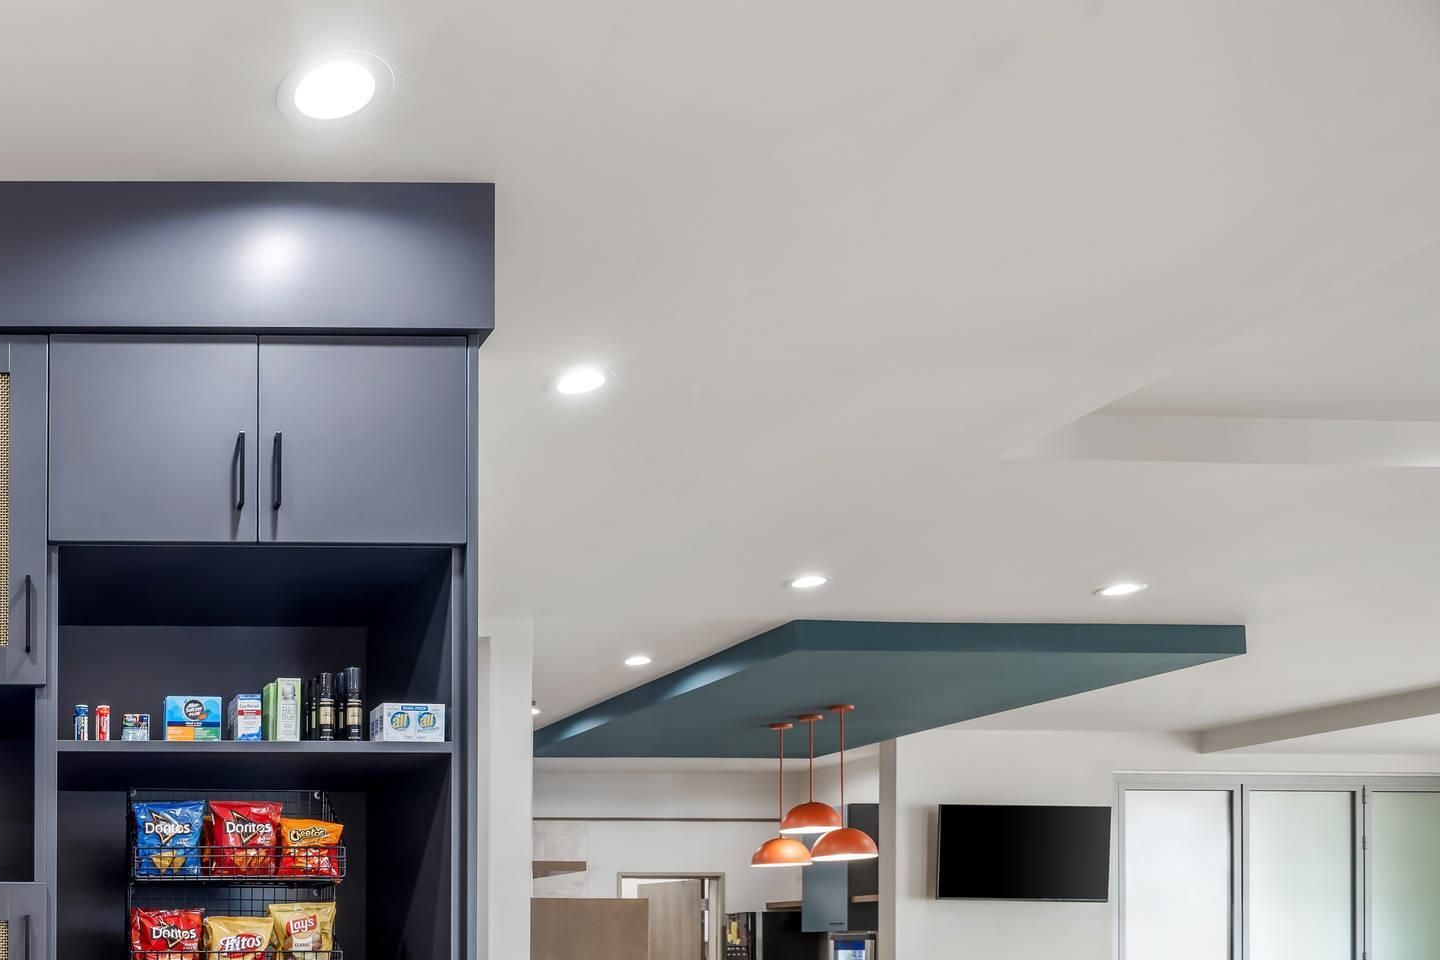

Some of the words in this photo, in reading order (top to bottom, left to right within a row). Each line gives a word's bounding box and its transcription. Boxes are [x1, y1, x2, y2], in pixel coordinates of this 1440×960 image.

[392, 713, 409, 728] all
[419, 713, 434, 728] all
[144, 822, 192, 834] Doritos
[226, 822, 272, 834] Doritos
[289, 827, 326, 843] Cheetos
[152, 926, 197, 939] Doritos
[290, 918, 314, 934] Lay's
[219, 936, 262, 952] Fritos
